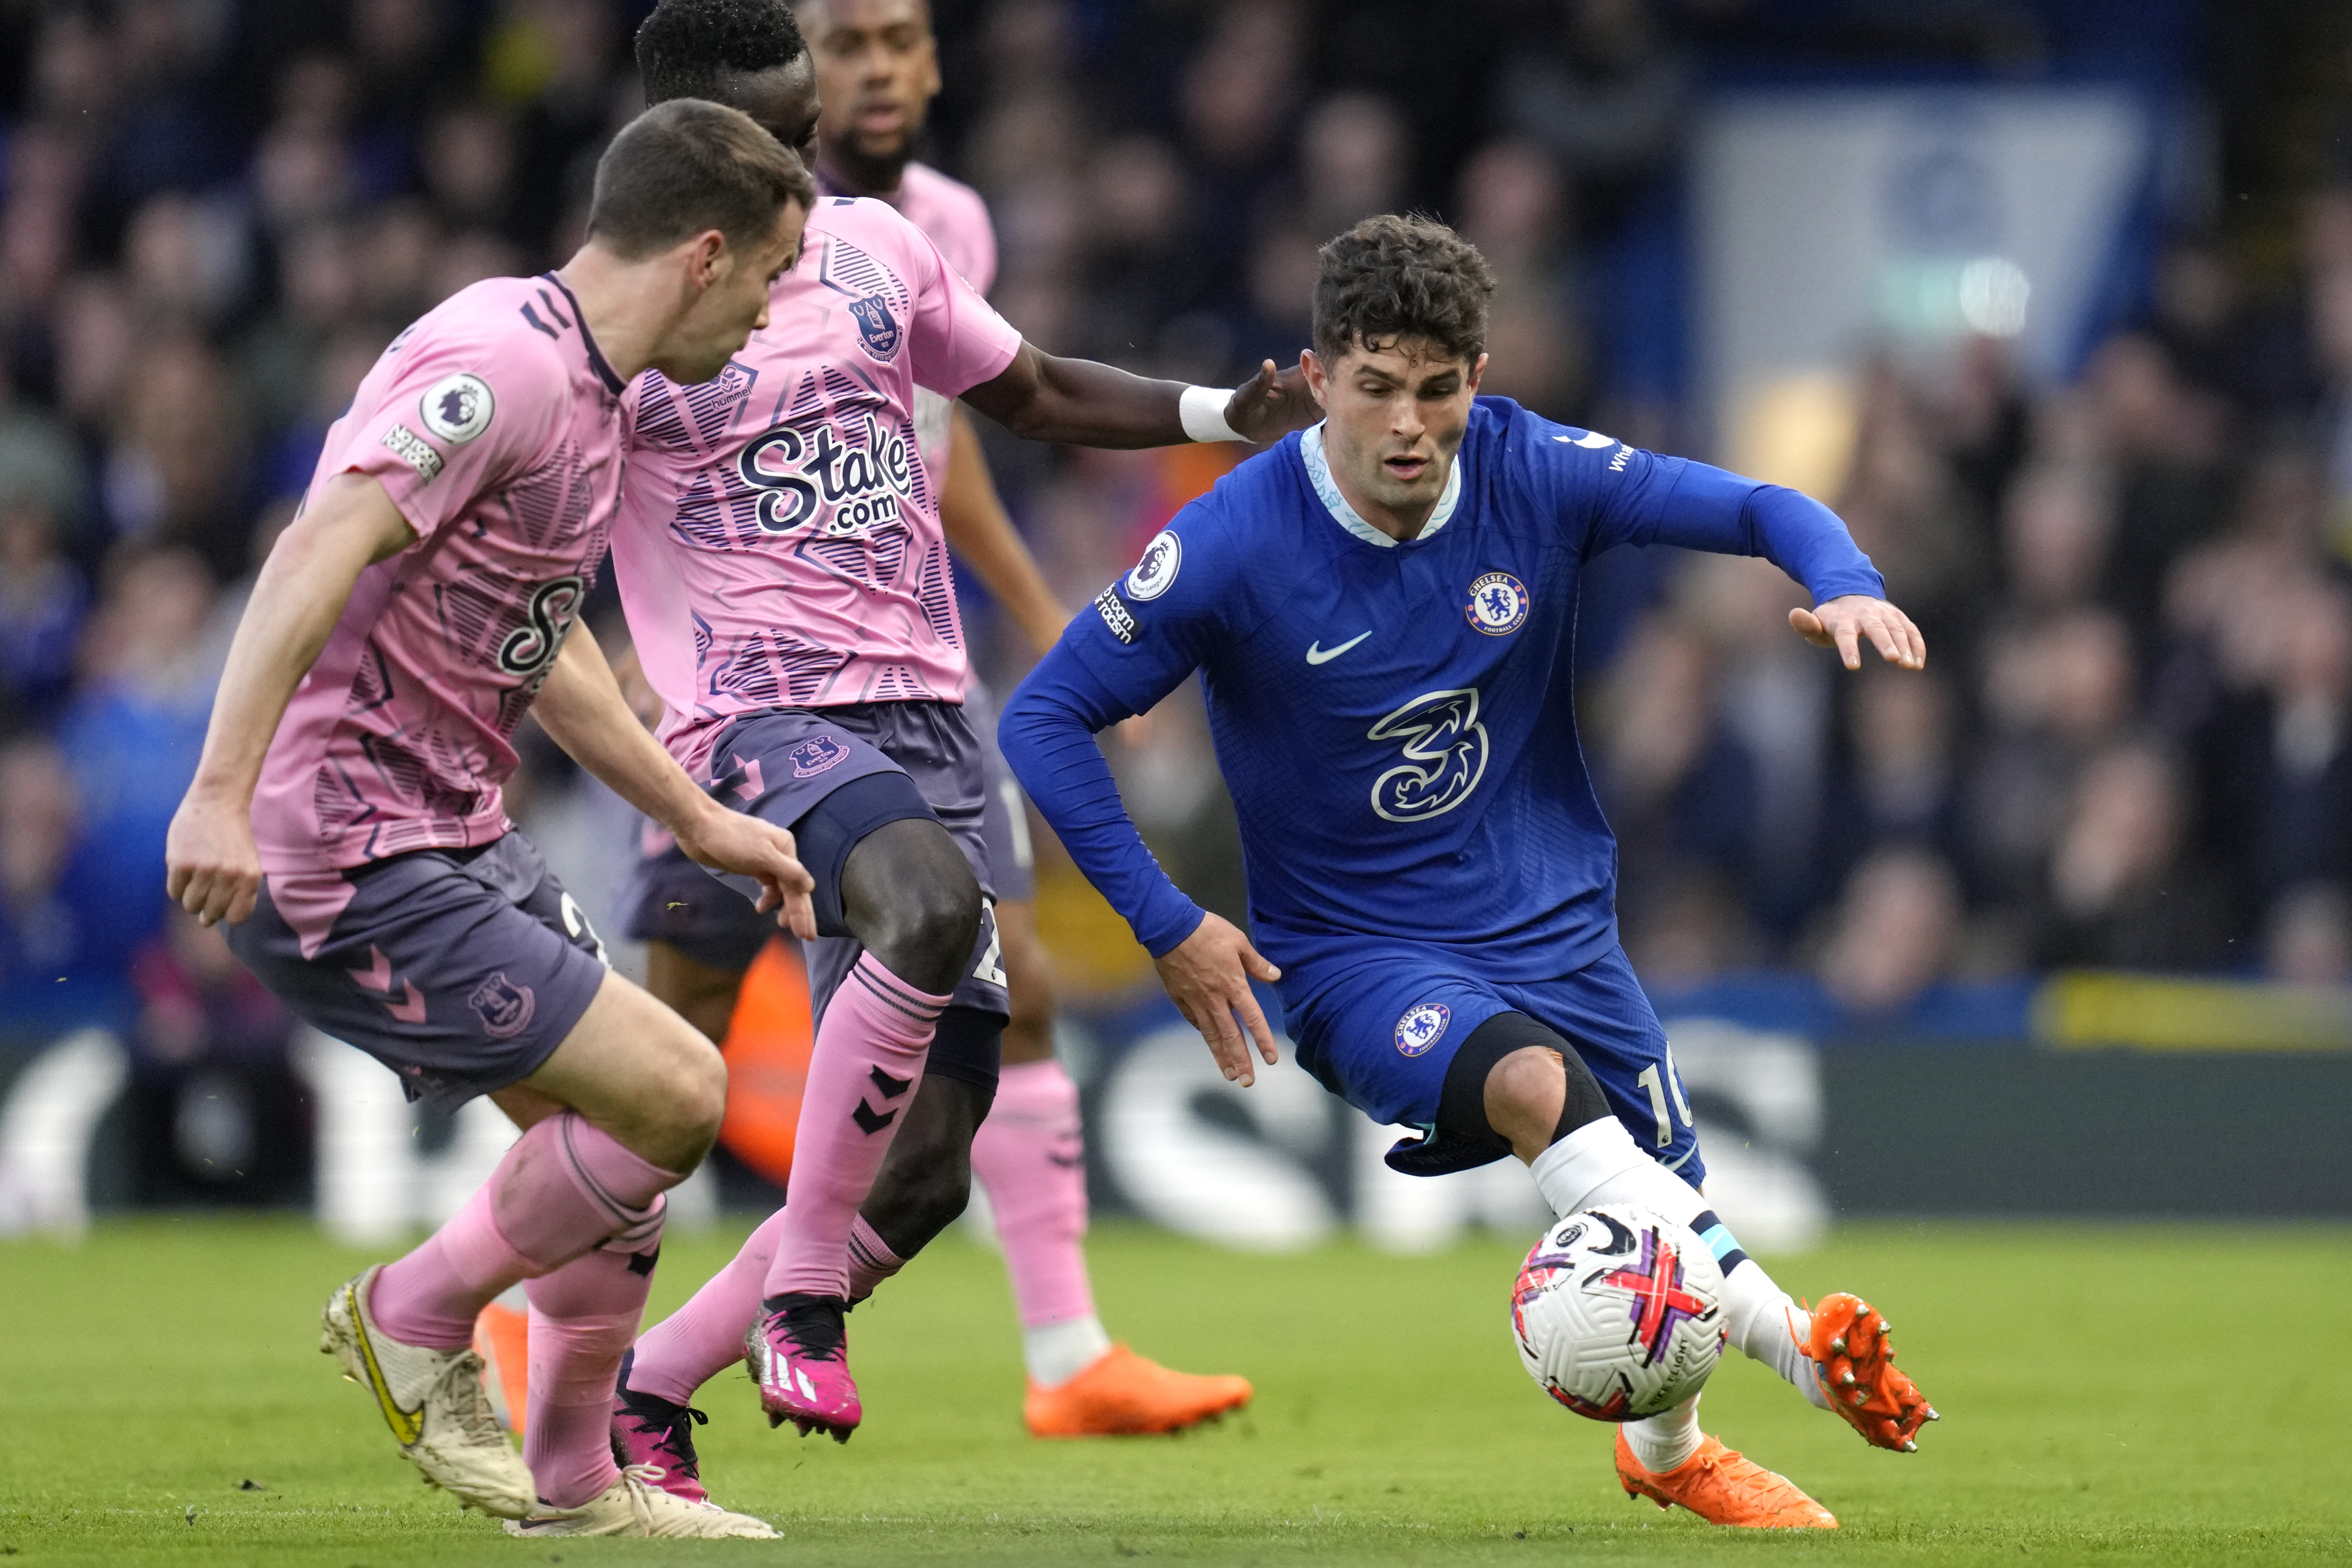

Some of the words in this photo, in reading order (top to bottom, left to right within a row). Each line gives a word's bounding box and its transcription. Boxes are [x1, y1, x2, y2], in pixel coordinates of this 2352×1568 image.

[869, 330, 894, 343] Everton
[711, 385, 752, 409] hummel
[385, 423, 413, 447] No
[1609, 444, 1634, 472] Wha
[737, 413, 912, 535] Stake
[827, 491, 899, 535] .com
[1146, 576, 1164, 591] League
[1470, 575, 1508, 596] CHELSEA
[1098, 602, 1132, 644] racism
[1107, 594, 1134, 631] room
[1512, 612, 1523, 625] CLUB
[806, 750, 835, 766] Everton
[1397, 1006, 1427, 1036] CHELSEA
[1419, 1032, 1440, 1052] FOOTBALL
[1667, 1338, 1687, 1385] FLIGHT
